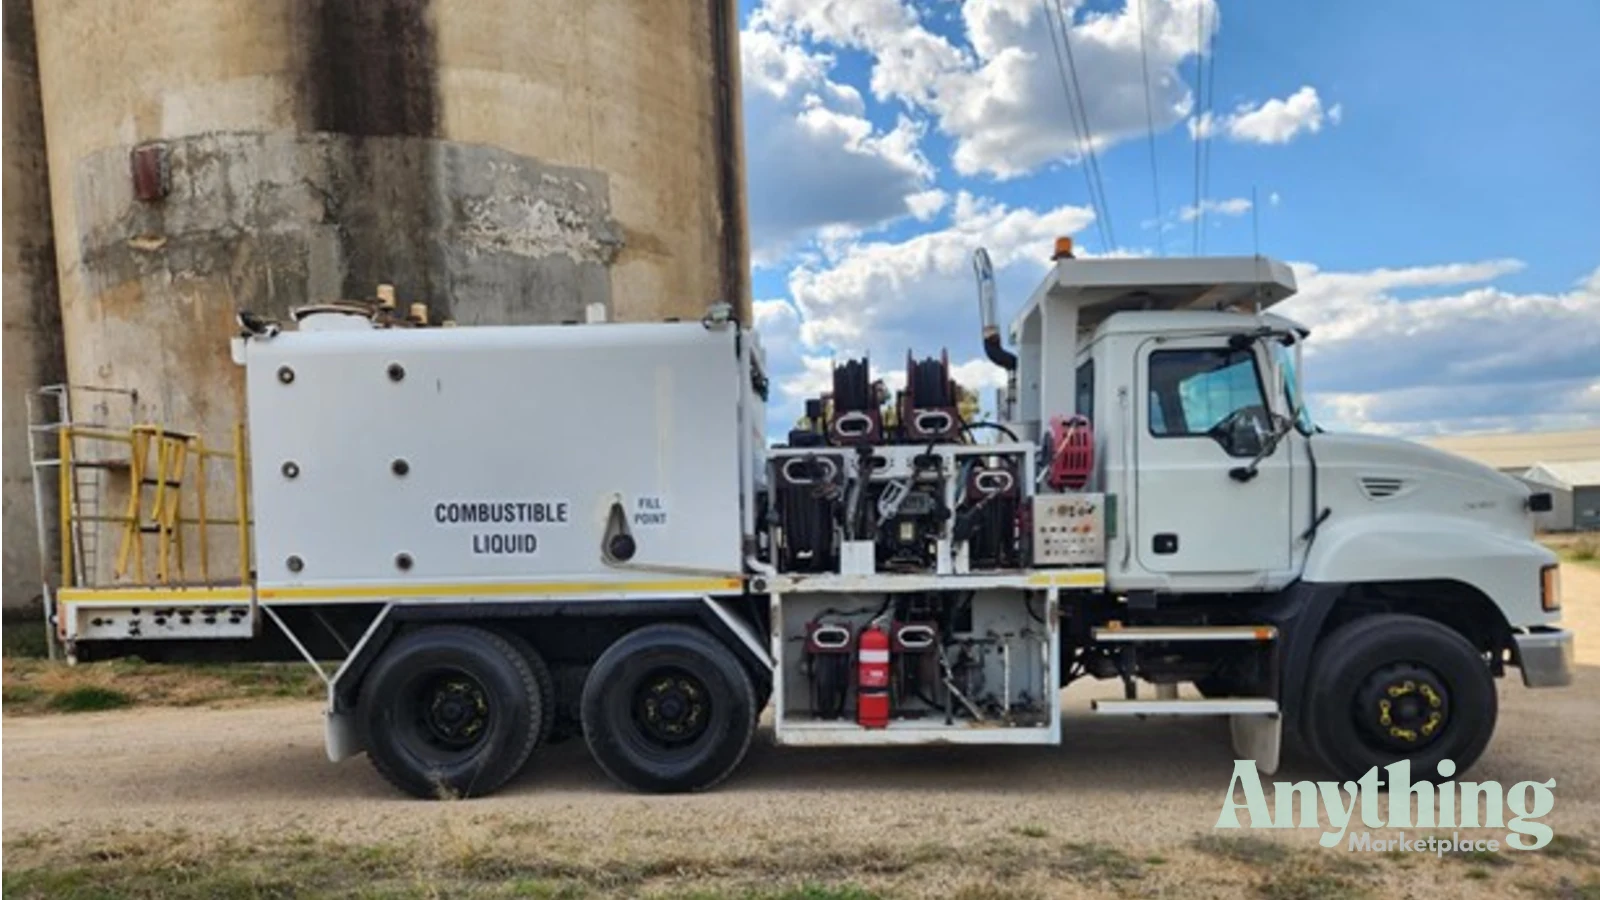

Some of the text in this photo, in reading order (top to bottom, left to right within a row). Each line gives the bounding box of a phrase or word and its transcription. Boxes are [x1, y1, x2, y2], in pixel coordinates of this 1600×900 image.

[638, 497, 661, 509] FILL
[434, 502, 567, 523] COMBUSTIBLE
[634, 513, 666, 525] POINT
[472, 533, 537, 554] LIQUID
